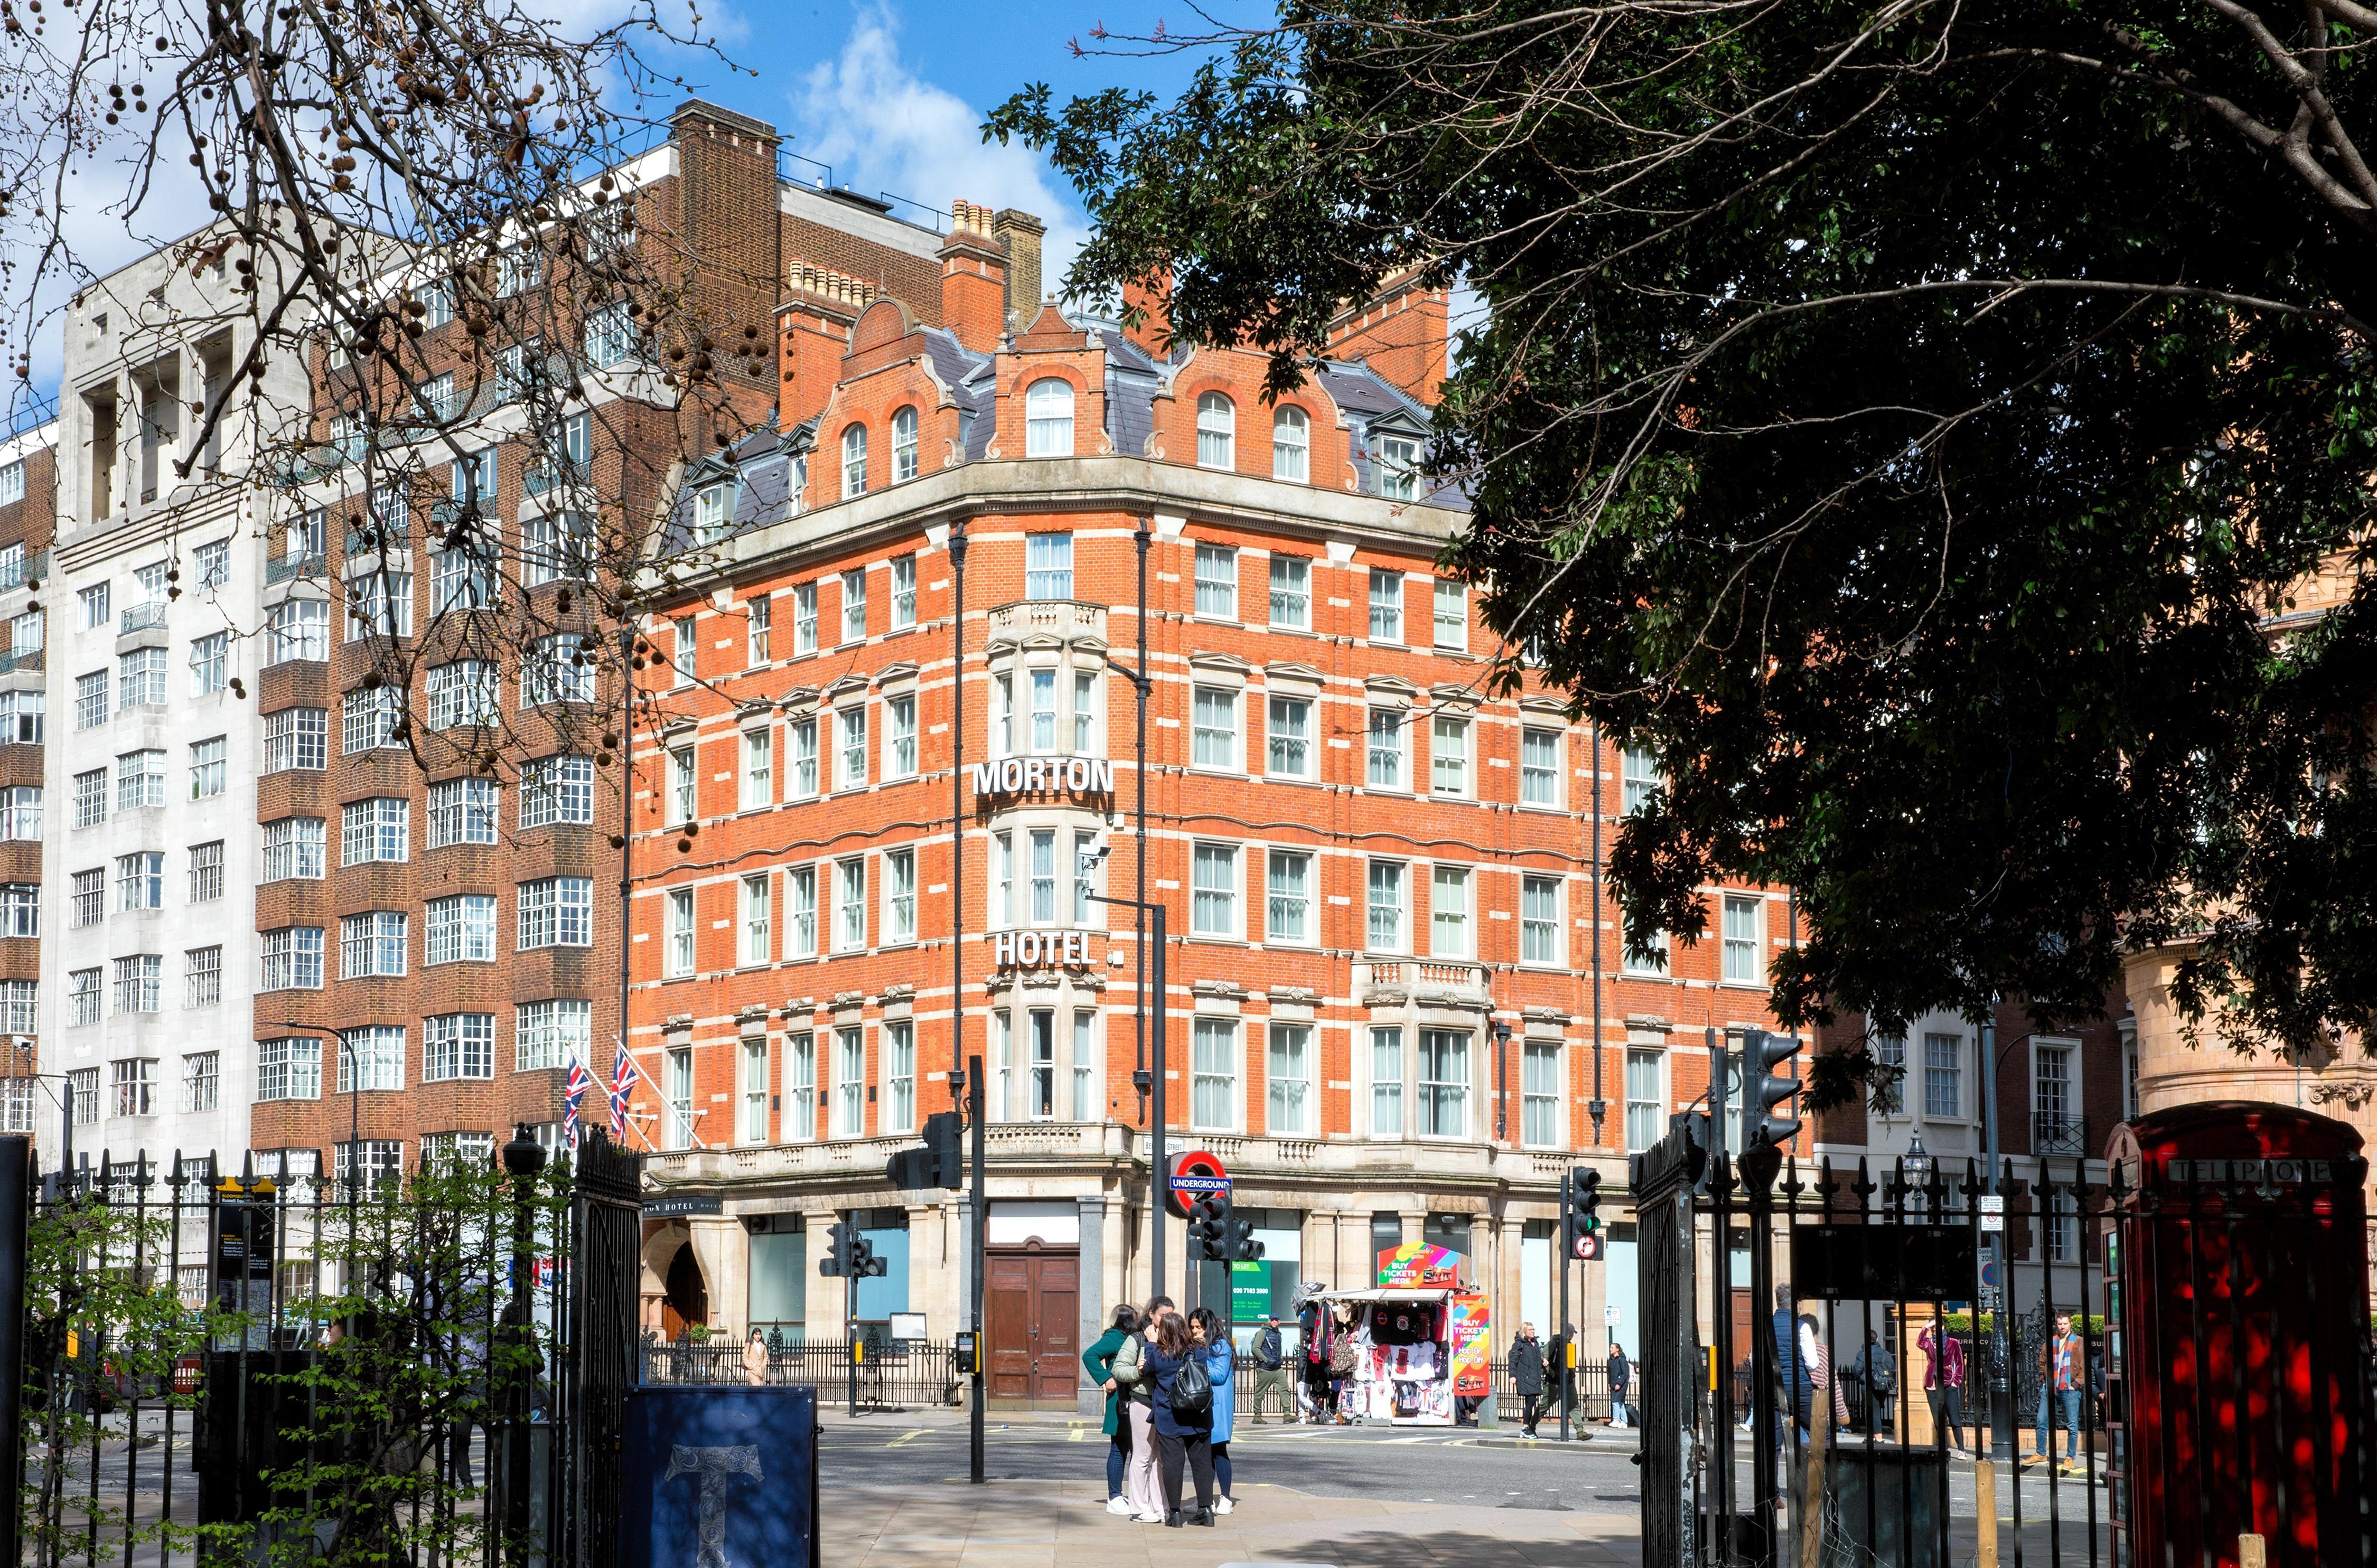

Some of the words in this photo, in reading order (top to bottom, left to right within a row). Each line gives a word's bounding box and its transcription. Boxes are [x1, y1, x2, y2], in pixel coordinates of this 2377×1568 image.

[972, 758, 1113, 795] MORTON
[995, 932, 1097, 965] HOTEL
[1173, 1179, 1229, 1188] UNDERGROUND
[666, 1203, 693, 1211] HOTEL
